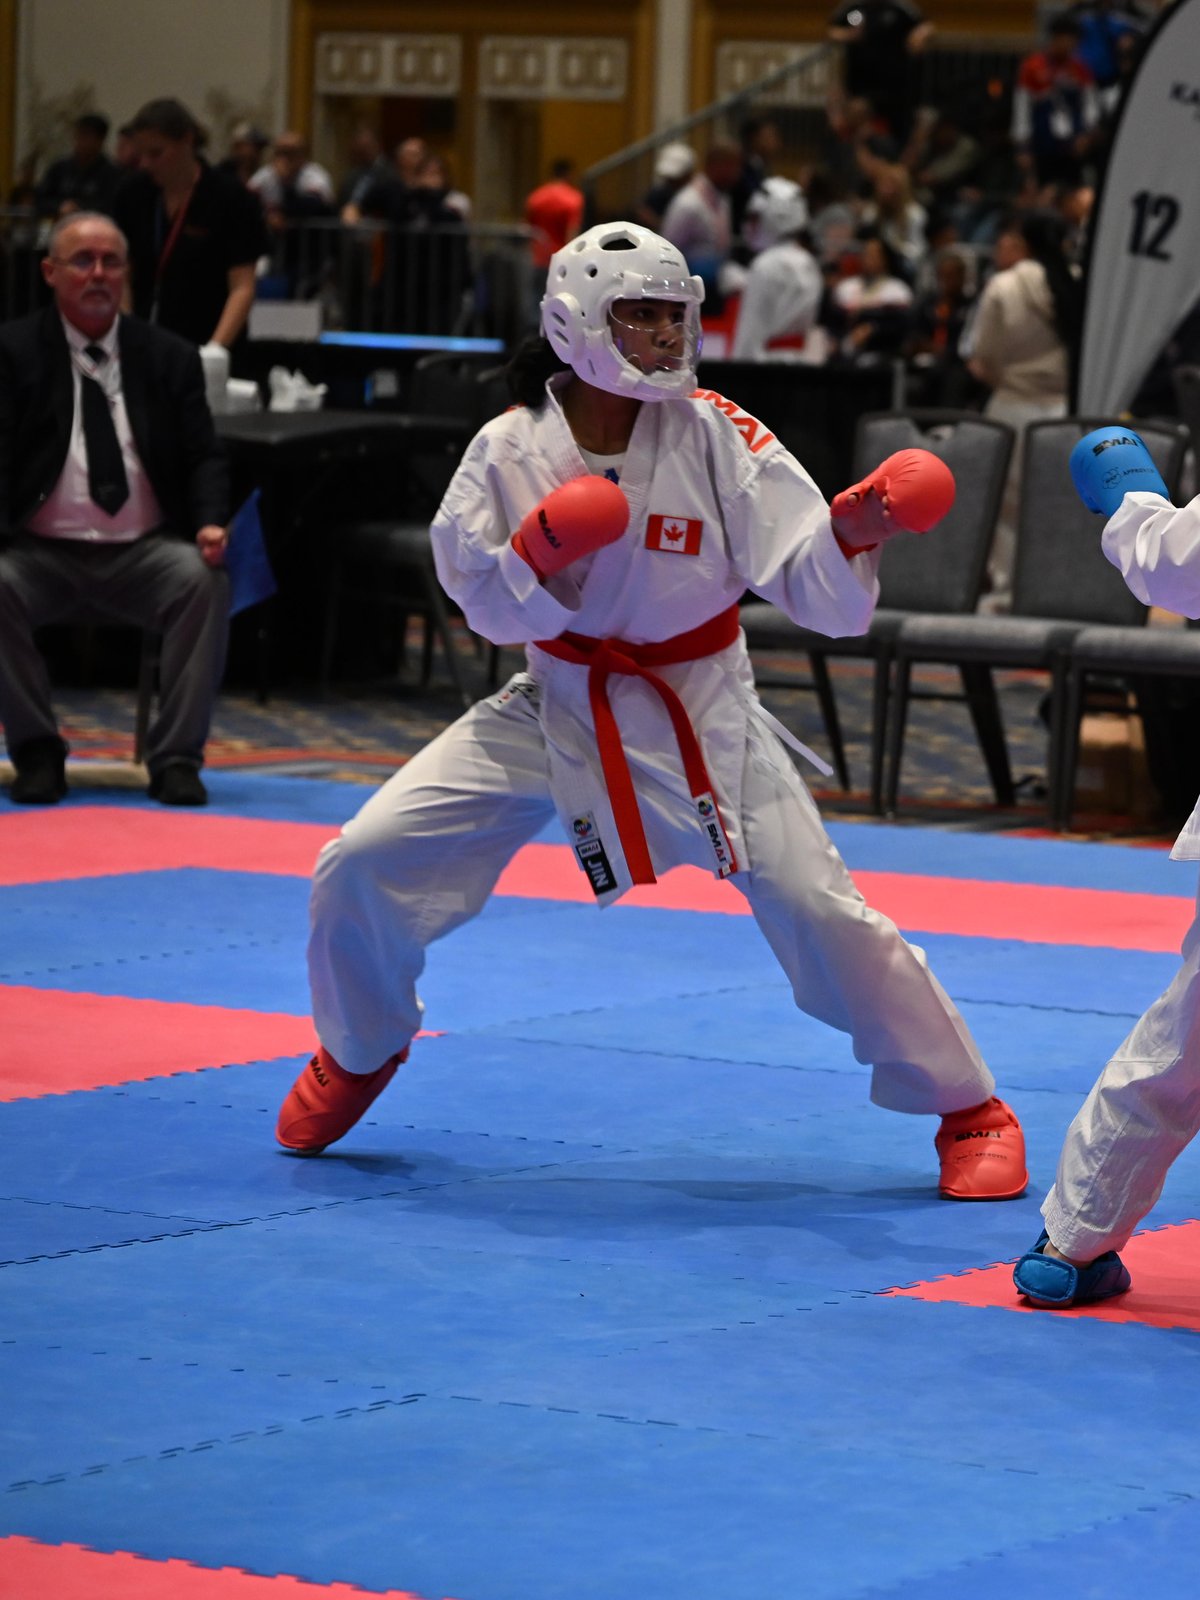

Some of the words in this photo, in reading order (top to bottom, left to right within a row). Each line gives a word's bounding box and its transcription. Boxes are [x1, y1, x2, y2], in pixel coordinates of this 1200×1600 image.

[1128, 190, 1181, 262] 12
[1092, 436, 1139, 457] SMAI
[537, 509, 562, 549] SMAI
[706, 823, 728, 863] SMAI
[587, 859, 610, 889] JIN
